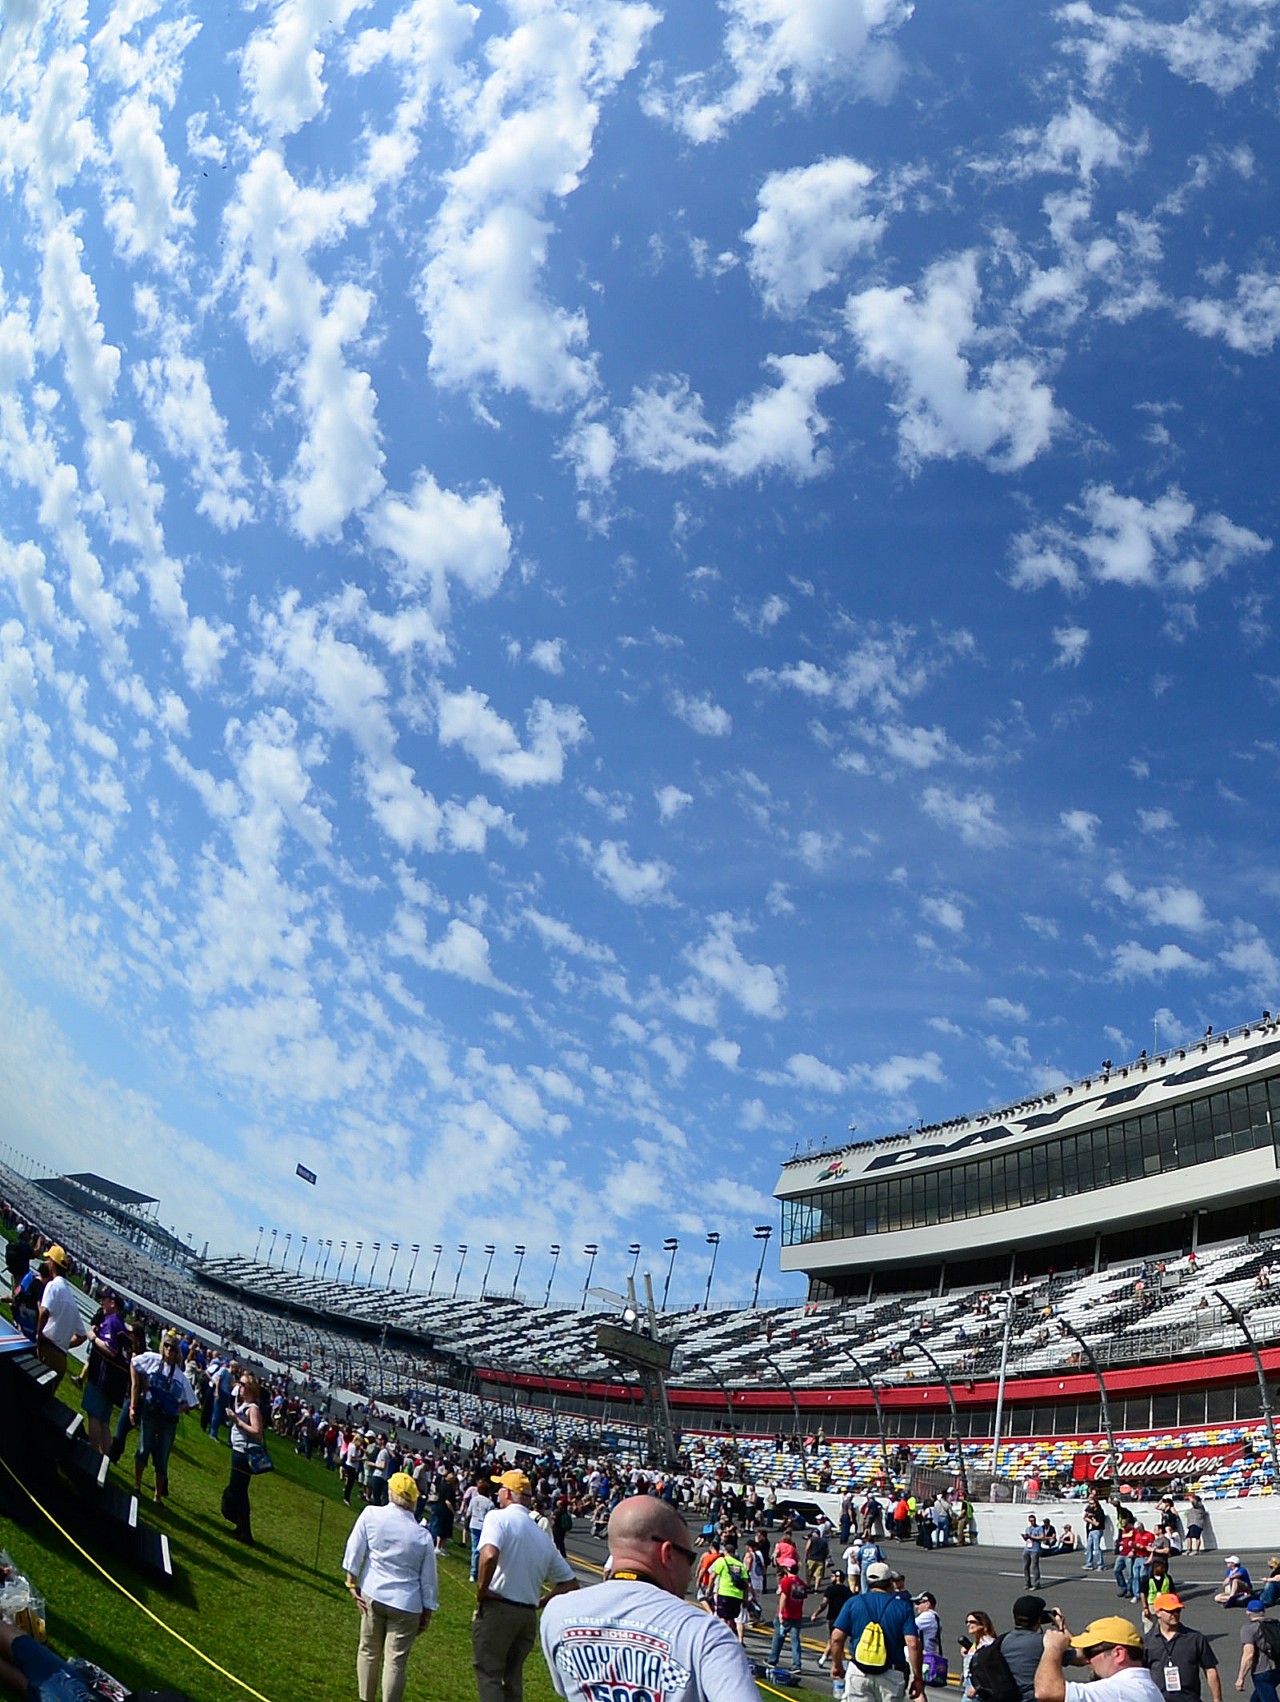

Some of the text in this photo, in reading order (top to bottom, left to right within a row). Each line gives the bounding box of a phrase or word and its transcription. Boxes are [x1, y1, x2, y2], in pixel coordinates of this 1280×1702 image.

[1090, 1451, 1224, 1480] Budweiser
[564, 1616, 577, 1624] THE
[579, 1616, 604, 1625] GREAT
[646, 1623, 671, 1638] RACE
[570, 1644, 663, 1691] DAYTONA
